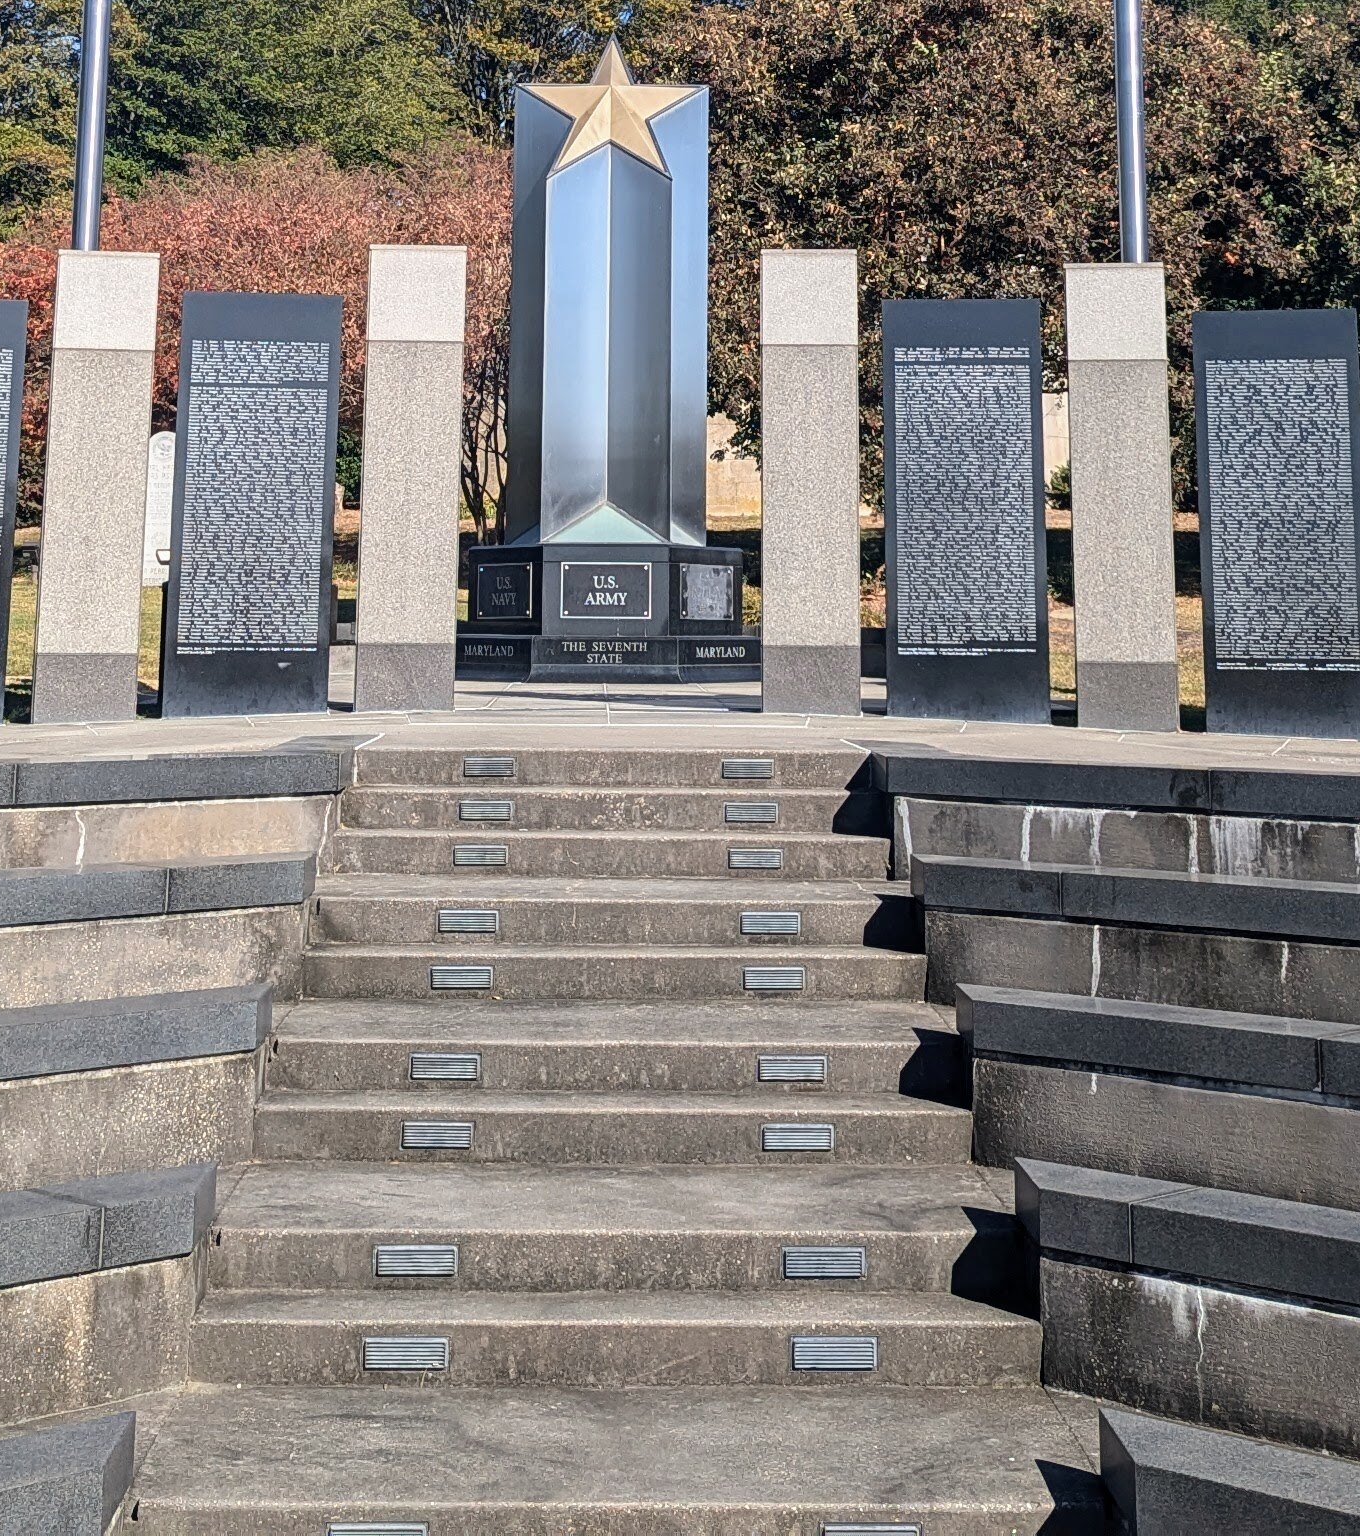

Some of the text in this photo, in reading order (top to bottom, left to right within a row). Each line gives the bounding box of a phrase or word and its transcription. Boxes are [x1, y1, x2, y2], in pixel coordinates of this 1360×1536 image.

[496, 576, 512, 590] U.S.
[592, 575, 619, 589] U.S.
[491, 592, 517, 606] NAVY
[583, 592, 628, 606] ARMY
[463, 644, 515, 657] MARYLAND
[561, 641, 648, 652] THE SEVENTH
[695, 646, 746, 658] MARYLAND
[586, 653, 623, 664] STATE
